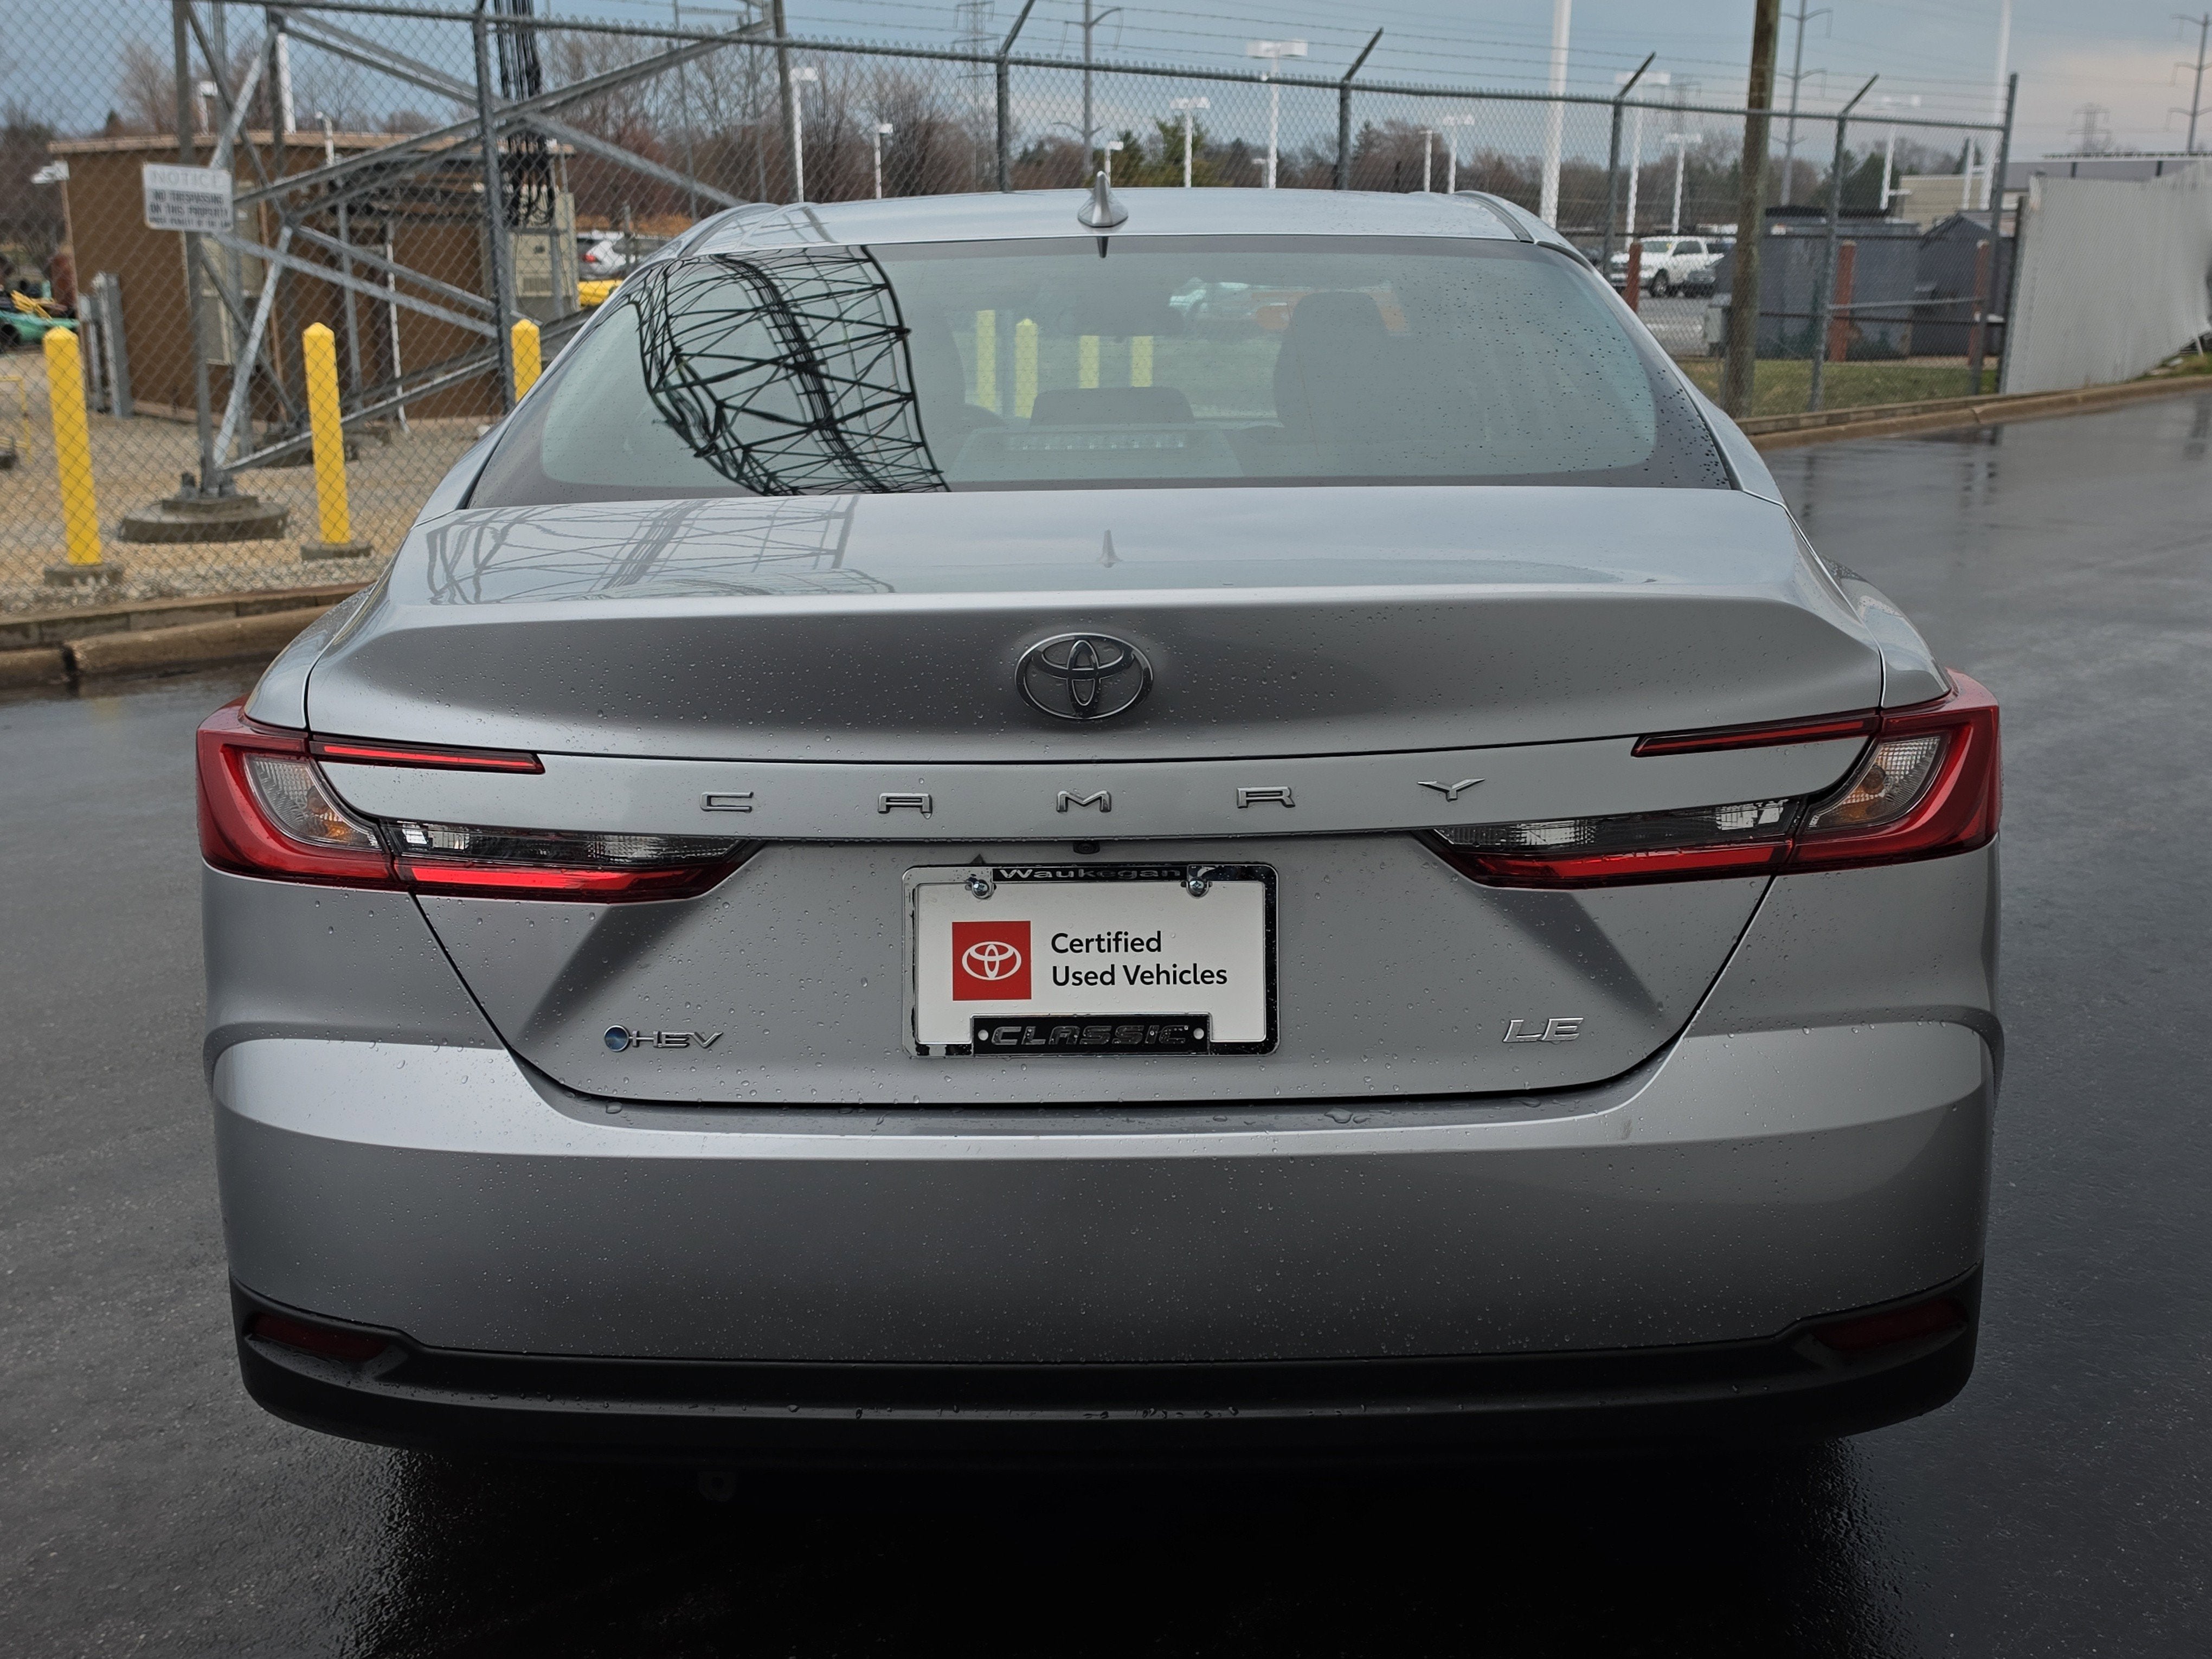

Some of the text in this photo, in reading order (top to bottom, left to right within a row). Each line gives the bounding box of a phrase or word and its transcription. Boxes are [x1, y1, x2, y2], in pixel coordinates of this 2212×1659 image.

[151, 170, 225, 188] NOTICE
[154, 189, 166, 202] NO
[700, 777, 1486, 814] CAMRY
[999, 869, 1181, 879] Waukegan
[1051, 931, 1162, 954] Certified
[1052, 963, 1228, 986] Used Vehicles
[991, 1025, 1189, 1046] CLASSIC
[1503, 1017, 1584, 1043] LE
